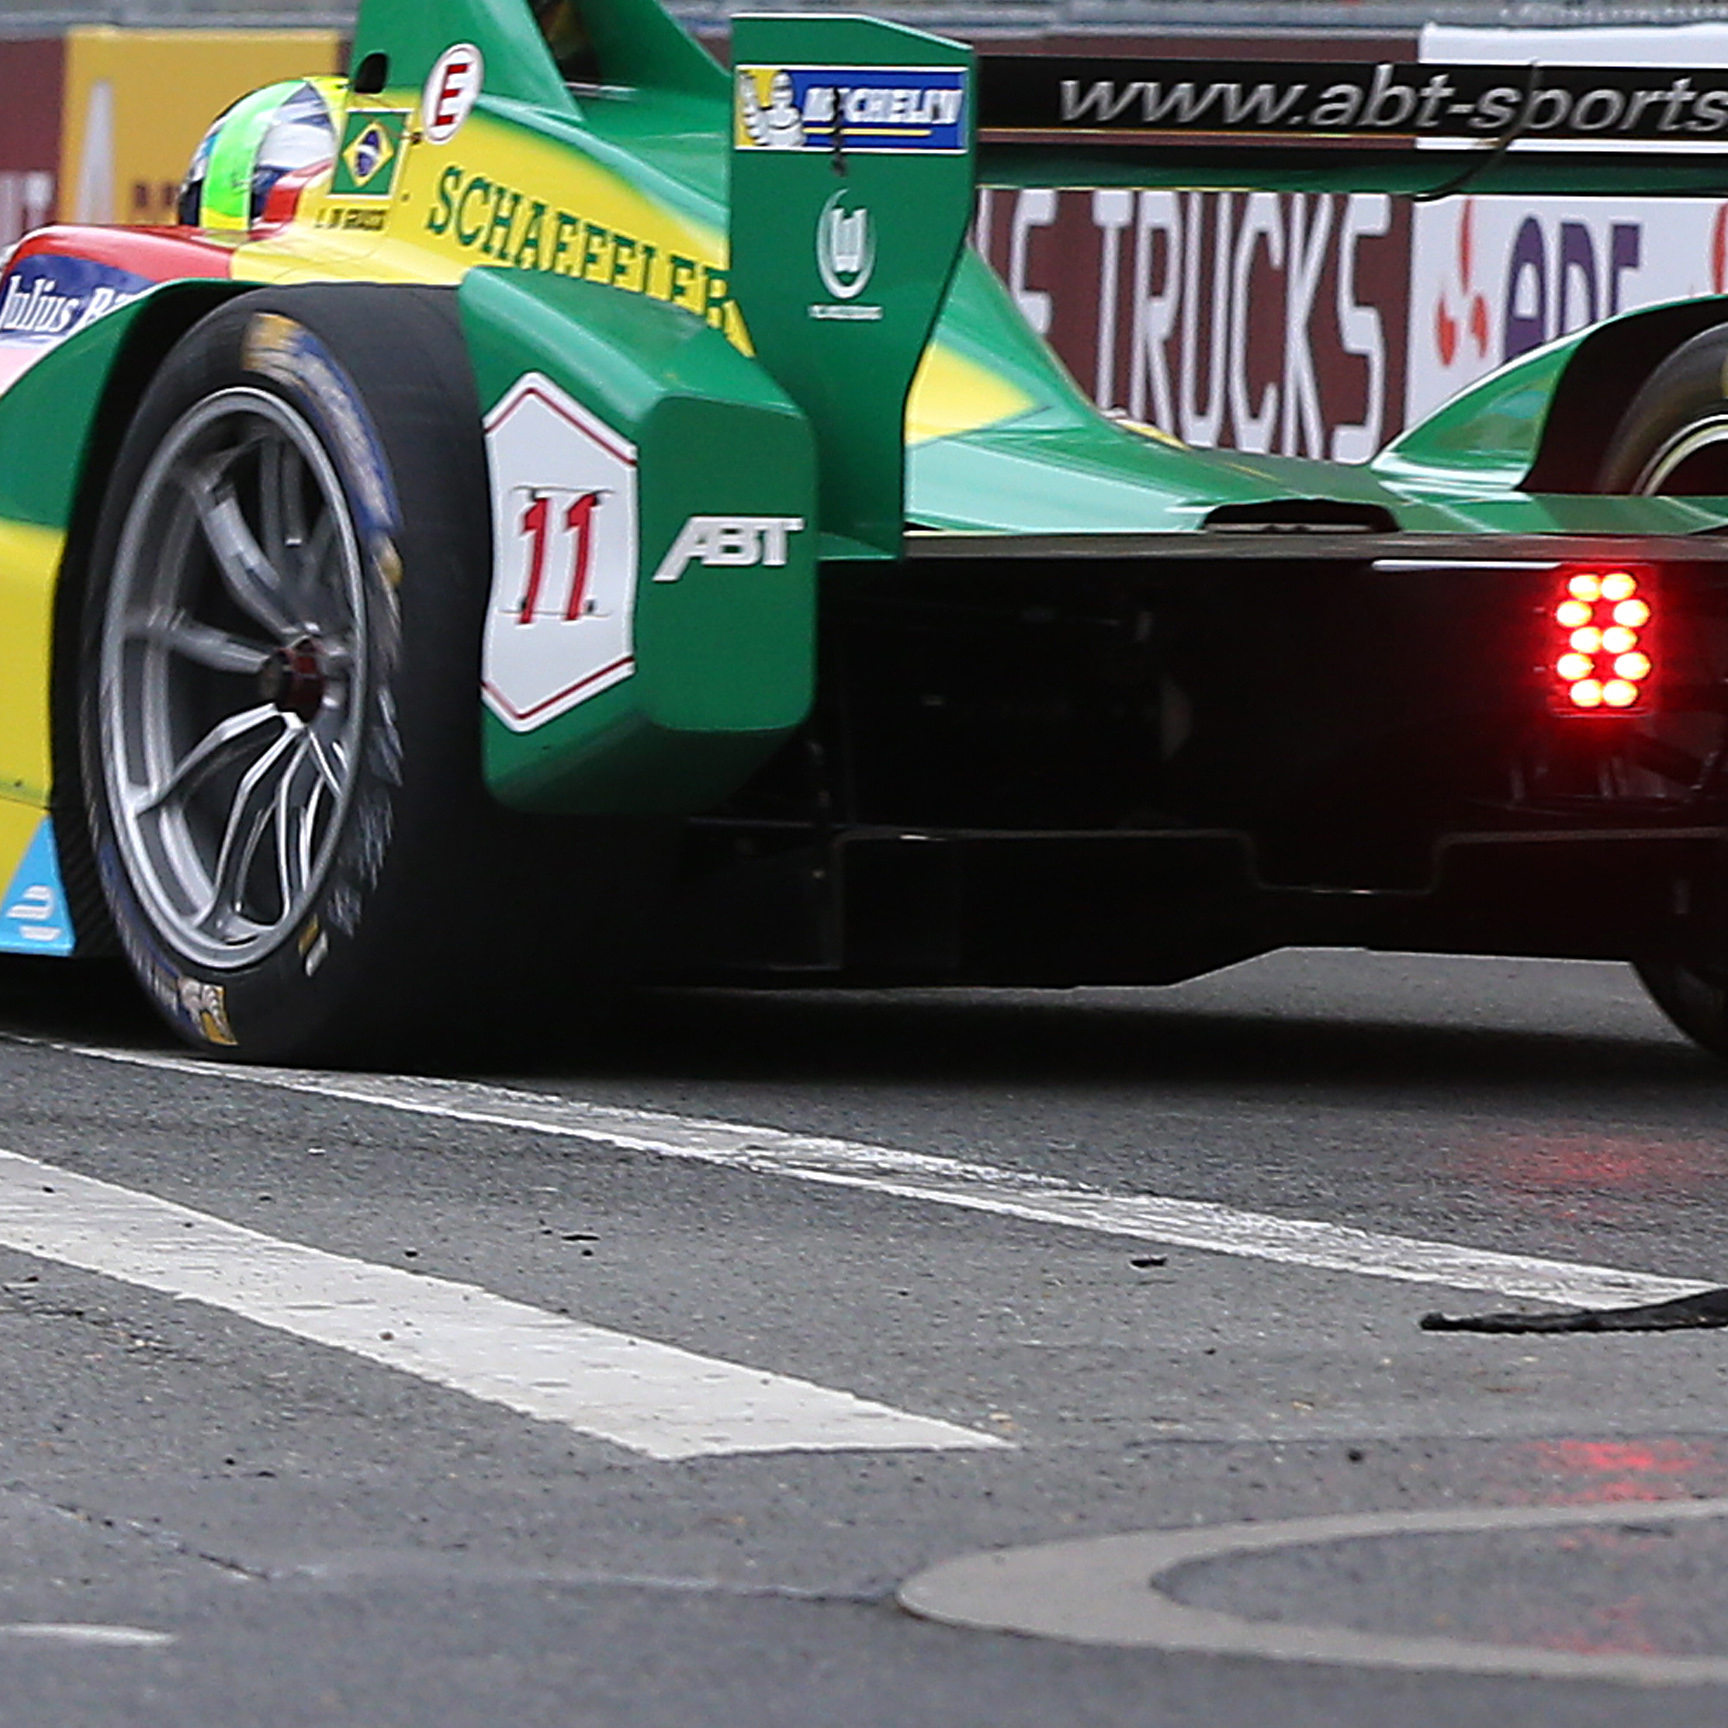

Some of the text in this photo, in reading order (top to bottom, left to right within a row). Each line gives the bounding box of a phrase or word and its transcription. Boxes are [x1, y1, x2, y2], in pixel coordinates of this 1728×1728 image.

[426, 164, 730, 328] SCHAEFFLER
[1092, 189, 1390, 464] TRUCKS
[518, 494, 596, 624] 11
[651, 516, 804, 581] ABT
